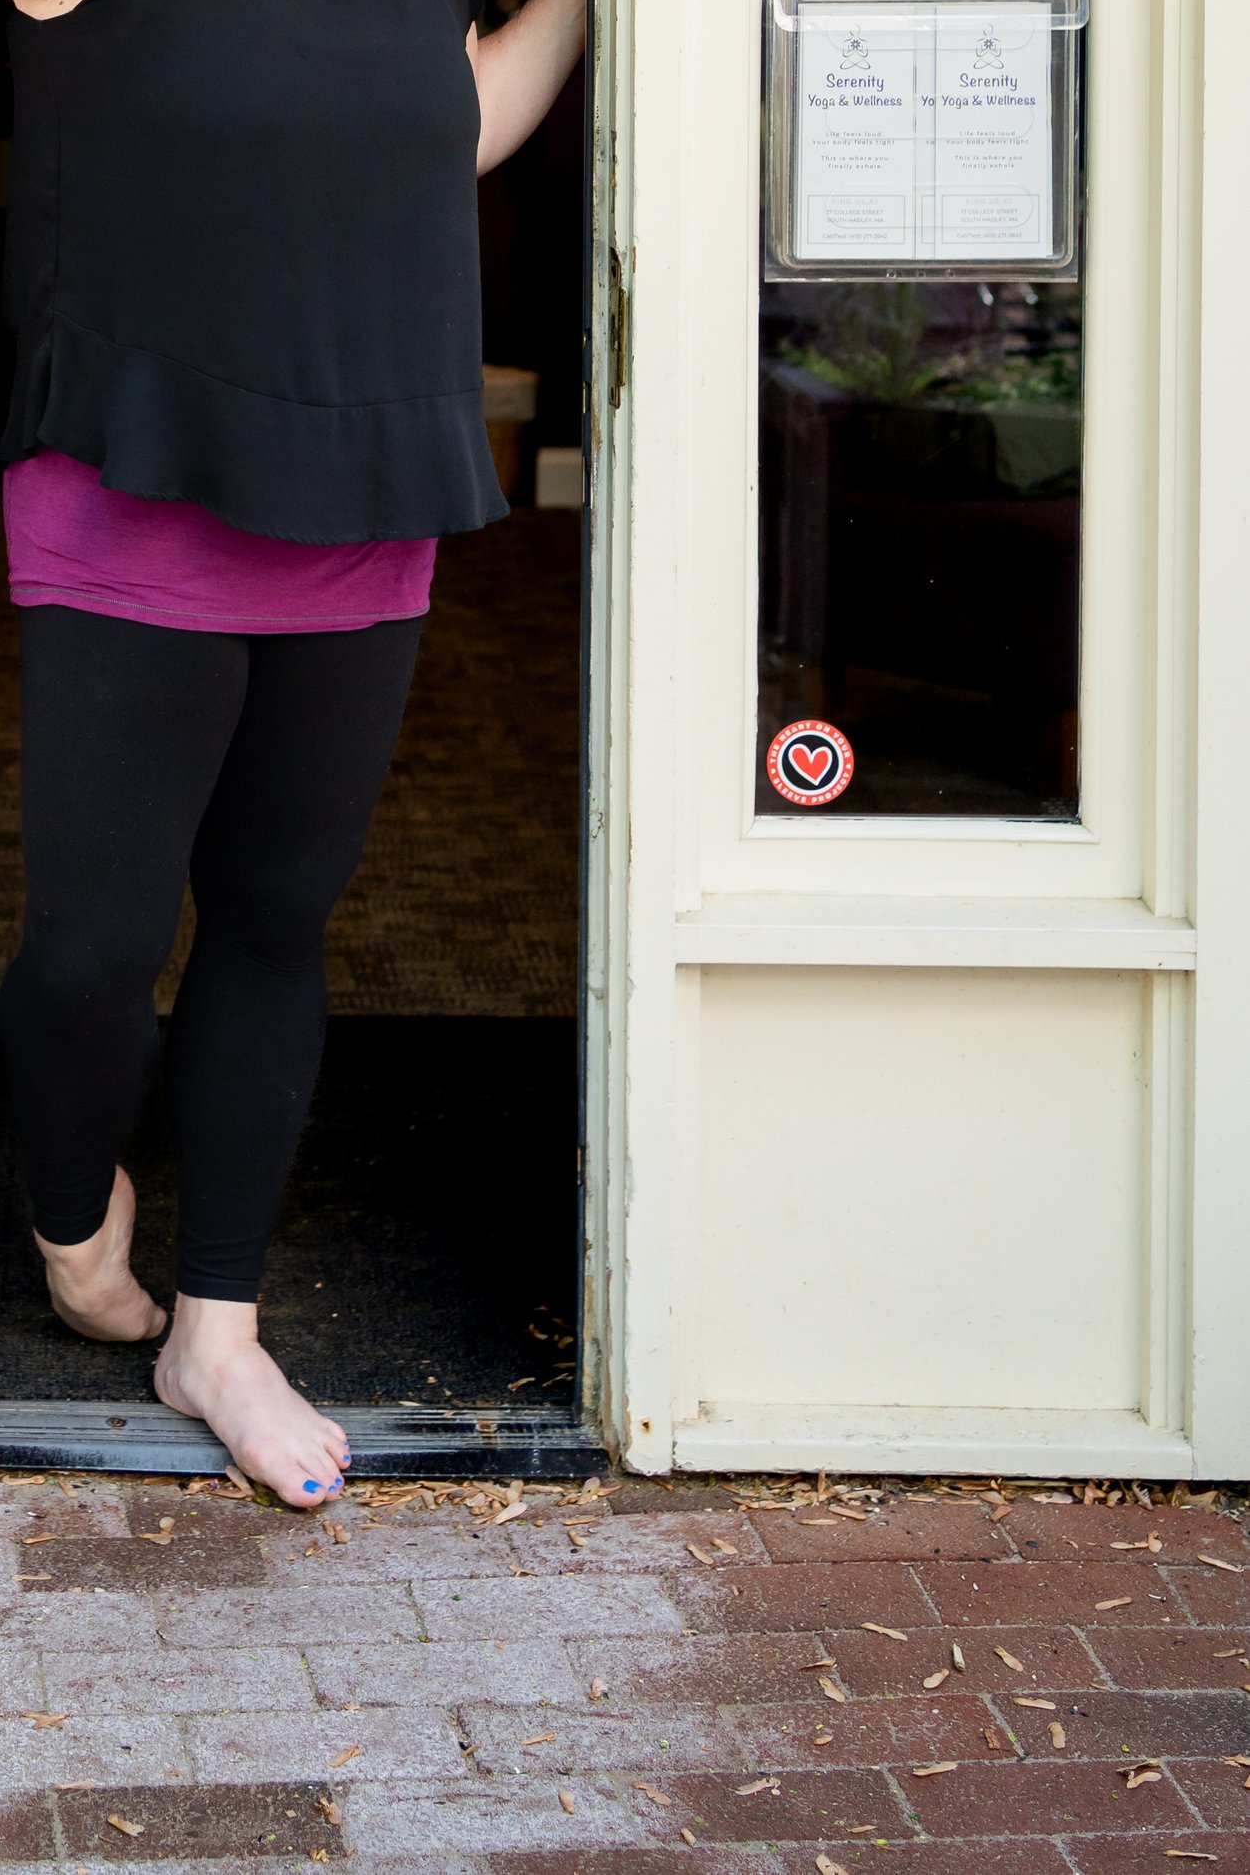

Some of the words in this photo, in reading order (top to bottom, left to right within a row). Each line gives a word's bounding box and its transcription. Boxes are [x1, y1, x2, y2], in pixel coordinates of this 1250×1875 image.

[826, 73, 884, 92] Serenity
[959, 73, 1018, 91] Serenity
[808, 94, 835, 109] Yoga
[839, 94, 849, 106] &
[853, 95, 902, 106] Wellness
[921, 95, 935, 106] Yo
[942, 95, 969, 109] Yoga
[972, 95, 982, 106] &
[986, 95, 1036, 106] Wellness
[770, 744, 780, 764] THE
[779, 722, 812, 742] HEART
[816, 723, 831, 733] ON
[833, 732, 851, 758] YOUR
[773, 777, 807, 803] SLEEVE
[811, 772, 850, 803] PROJECT
